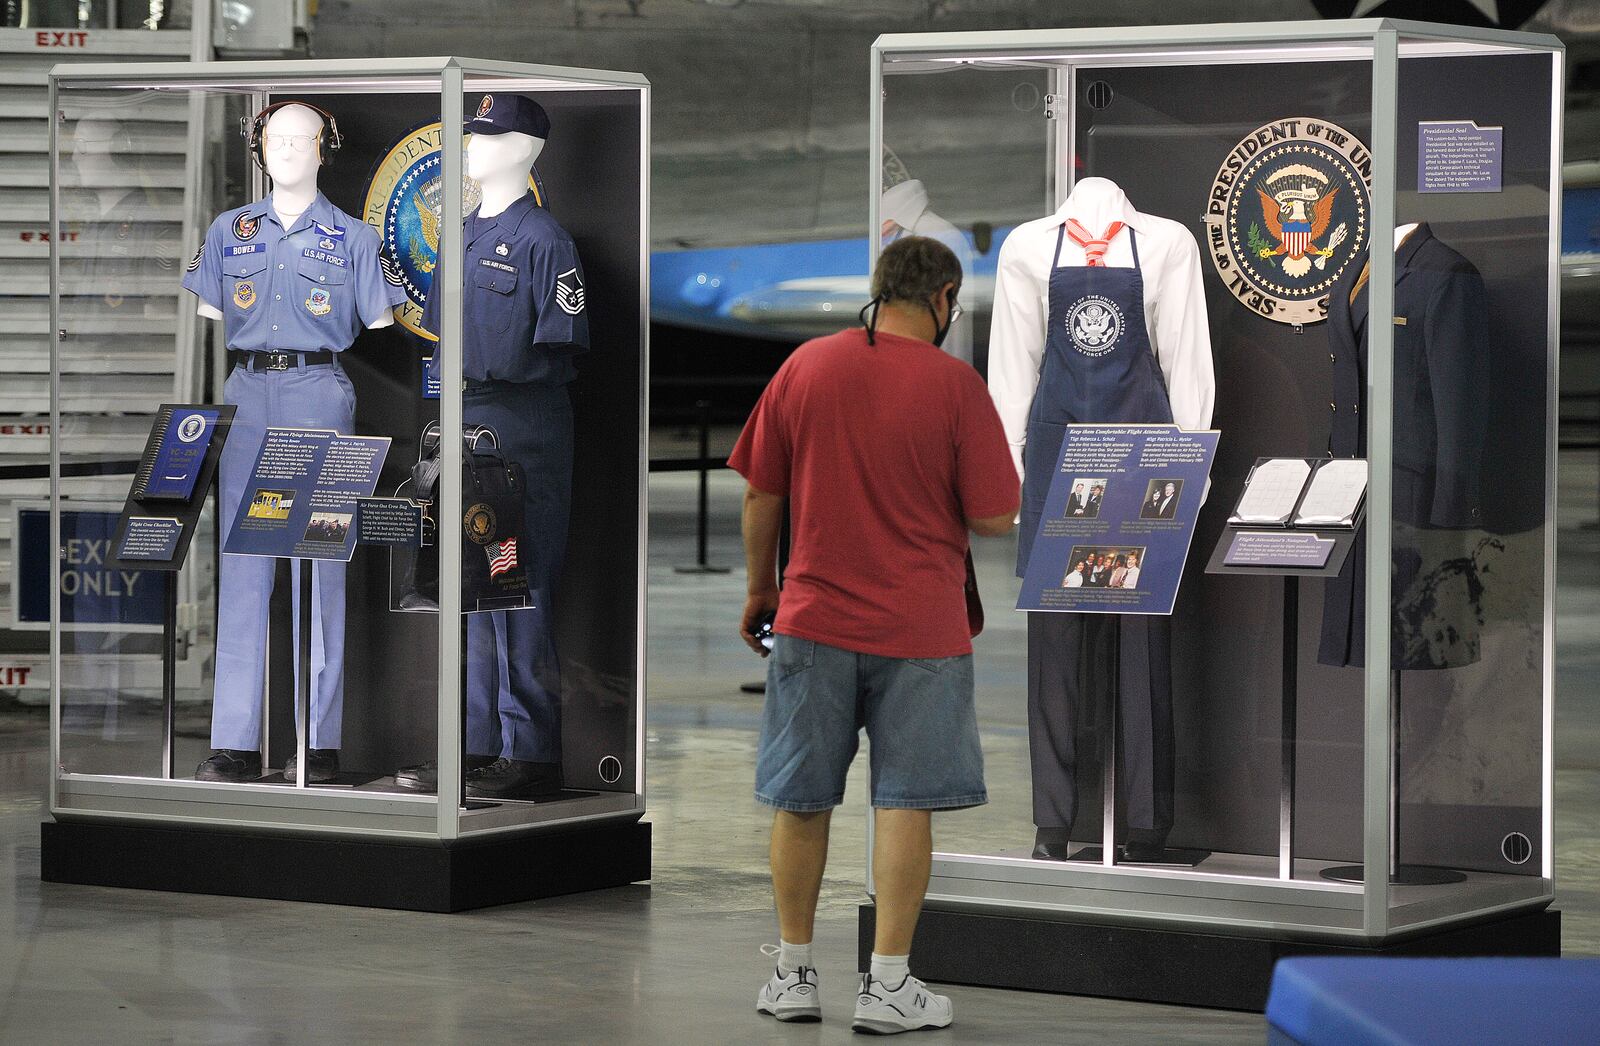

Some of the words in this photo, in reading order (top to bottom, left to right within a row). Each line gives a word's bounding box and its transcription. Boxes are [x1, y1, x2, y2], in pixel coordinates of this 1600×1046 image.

[36, 32, 89, 47] EXIT
[1210, 121, 1300, 215] PRESIDENT
[1306, 123, 1324, 138] OF
[1325, 127, 1348, 148] THE
[367, 129, 442, 227] PRESIDENT
[1211, 224, 1225, 249] THE
[233, 245, 256, 255] BOWEN
[304, 249, 316, 258] U.S.
[316, 252, 326, 261] AIR
[326, 255, 345, 267] FORCE
[1215, 251, 1231, 269] OF
[1228, 269, 1277, 315] SEAL
[1100, 296, 1120, 311] UNITED
[1103, 346, 1115, 355] ONE
[67, 539, 112, 565] EXI
[60, 570, 140, 597] ONLY
[0, 667, 31, 686] IT
[914, 993, 927, 1008] N
